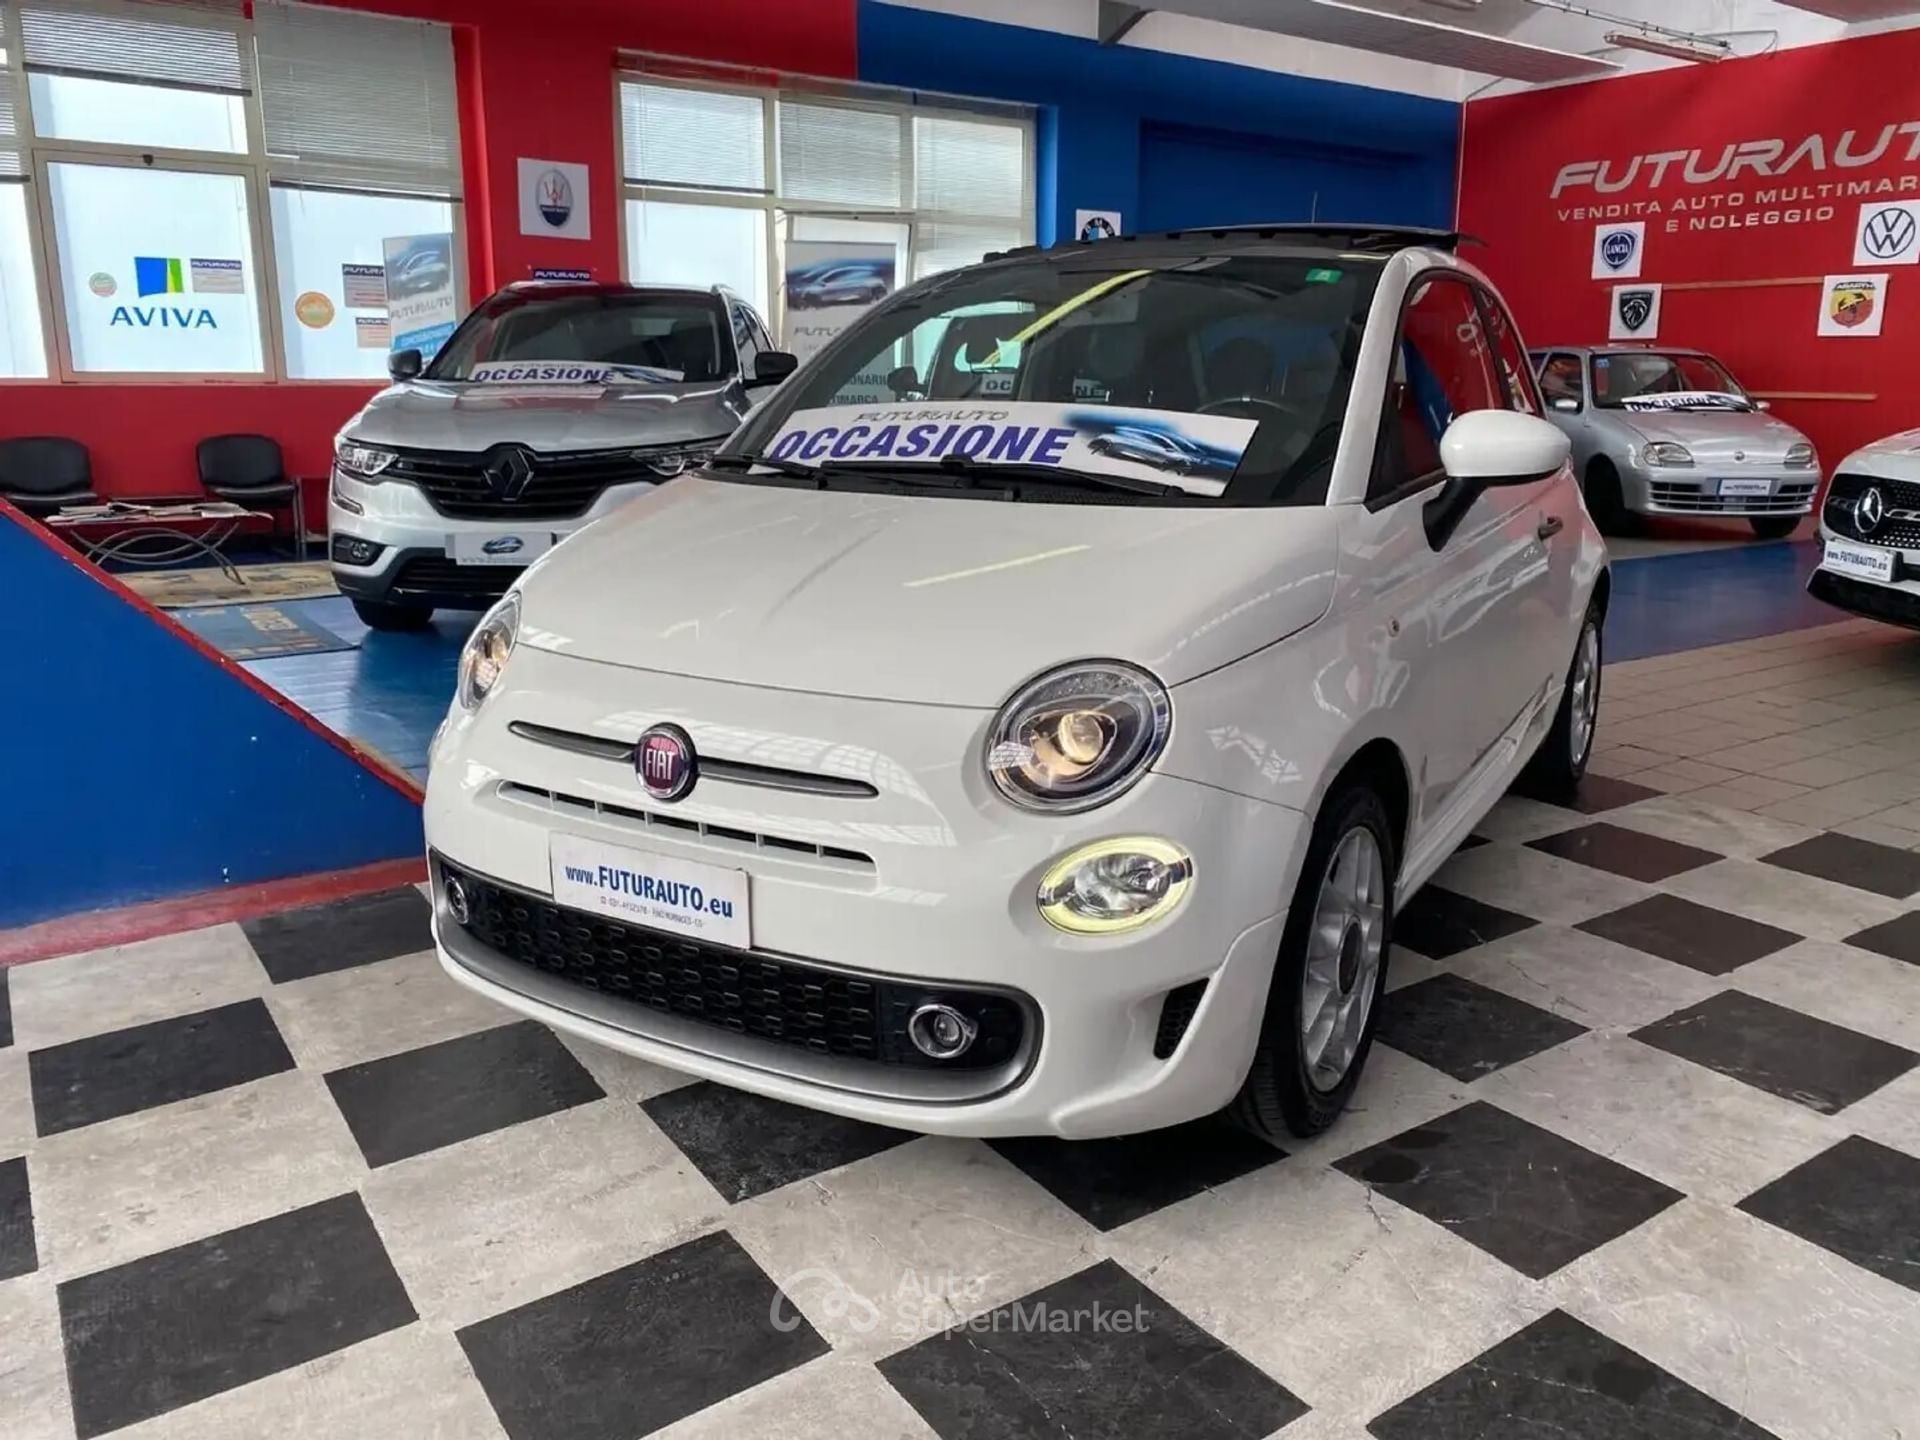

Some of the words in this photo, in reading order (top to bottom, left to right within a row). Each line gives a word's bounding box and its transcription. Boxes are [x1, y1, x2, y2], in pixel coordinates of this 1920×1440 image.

[1557, 201, 1662, 222] VENDITA
[1672, 192, 1744, 212] AUTO
[1666, 220, 1679, 232] E
[1689, 206, 1835, 231] NOLEGGIO
[110, 306, 217, 329] AVIVA
[474, 368, 616, 382] OCCASIONE
[854, 410, 1009, 422] FUTURAUTO
[769, 424, 1077, 464] OCCASIONE
[646, 748, 675, 780] FIAT
[566, 865, 733, 919] www.FUTURAUTO.eu
